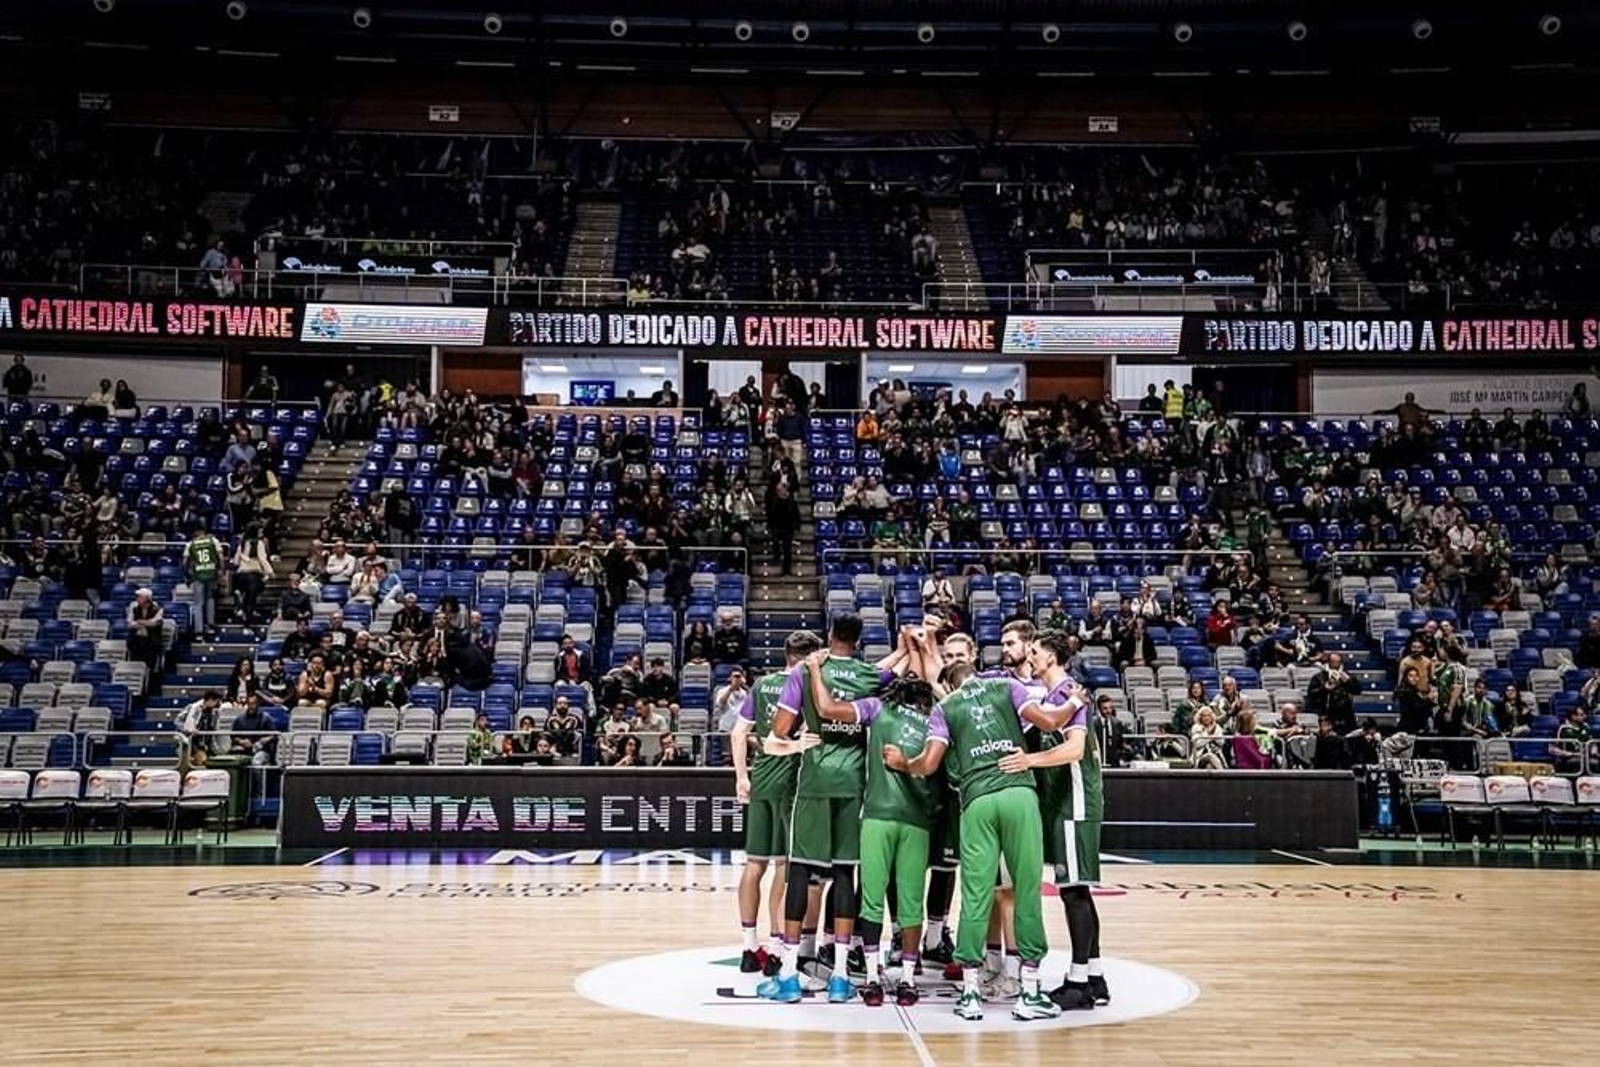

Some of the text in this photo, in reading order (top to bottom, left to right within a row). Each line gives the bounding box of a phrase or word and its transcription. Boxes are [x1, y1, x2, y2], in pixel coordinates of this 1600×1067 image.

[0, 297, 294, 338] A CATHEDRAL SOFTWARE
[509, 312, 601, 344] PARTIDO
[608, 314, 716, 345] DEDICADO
[722, 316, 739, 345] A
[744, 316, 869, 347] CATHEDRAL
[876, 318, 995, 349] SOFTWARE
[1204, 320, 1296, 351] PARTIDO
[1303, 320, 1413, 351] DEDICADO
[1420, 320, 1436, 350] A
[1443, 319, 1575, 350] CATHEDRAL
[1582, 319, 1600, 349] S
[196, 549, 210, 563] 16
[829, 668, 857, 679] SIMA
[970, 739, 1013, 758] málaga
[313, 795, 500, 832] VENTA
[512, 795, 587, 832] DE
